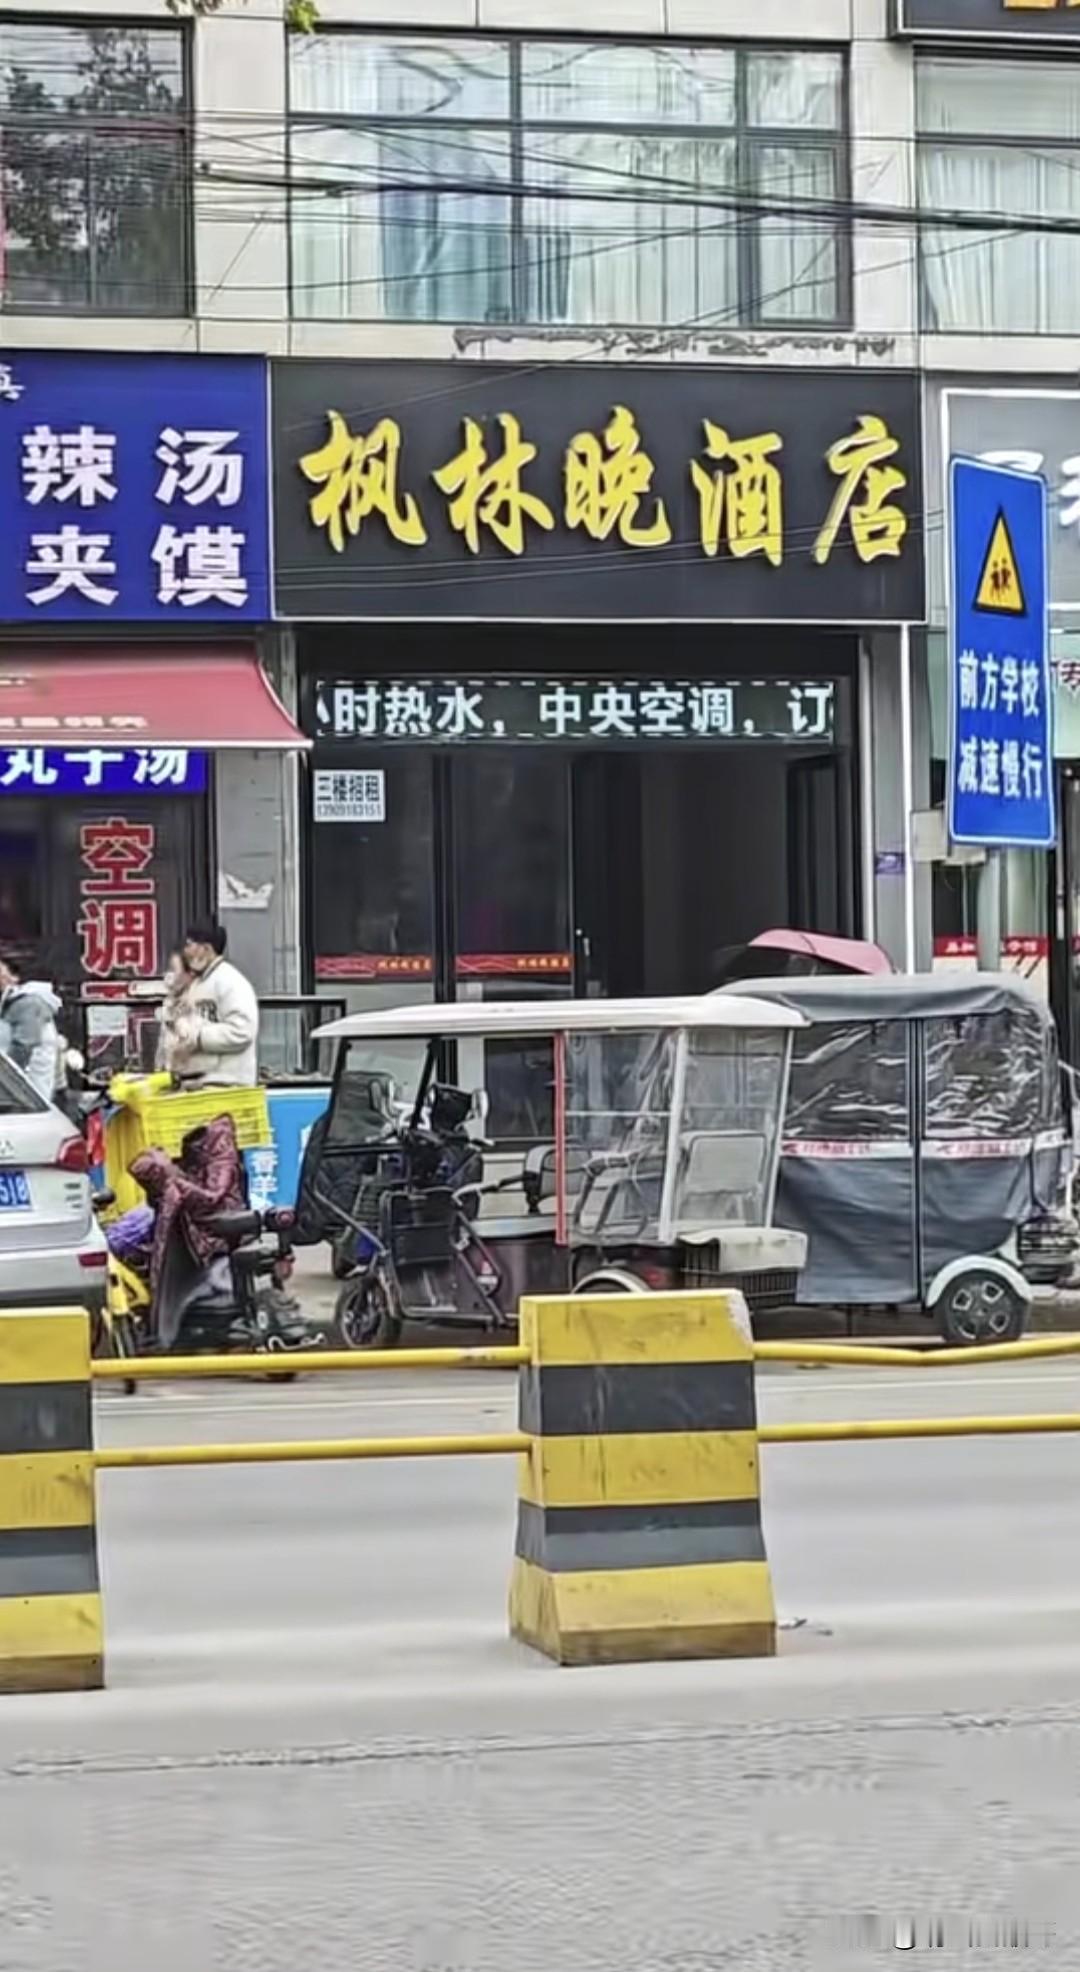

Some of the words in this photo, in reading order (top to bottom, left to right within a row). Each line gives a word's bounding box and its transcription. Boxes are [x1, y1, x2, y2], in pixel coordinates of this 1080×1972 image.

[21, 424, 244, 507] 辣汤
[300, 405, 907, 567] 枫林晚酒店
[25, 525, 248, 607] 夹馍
[959, 650, 1039, 717] 前方学校
[958, 732, 1043, 798] 减速慢行
